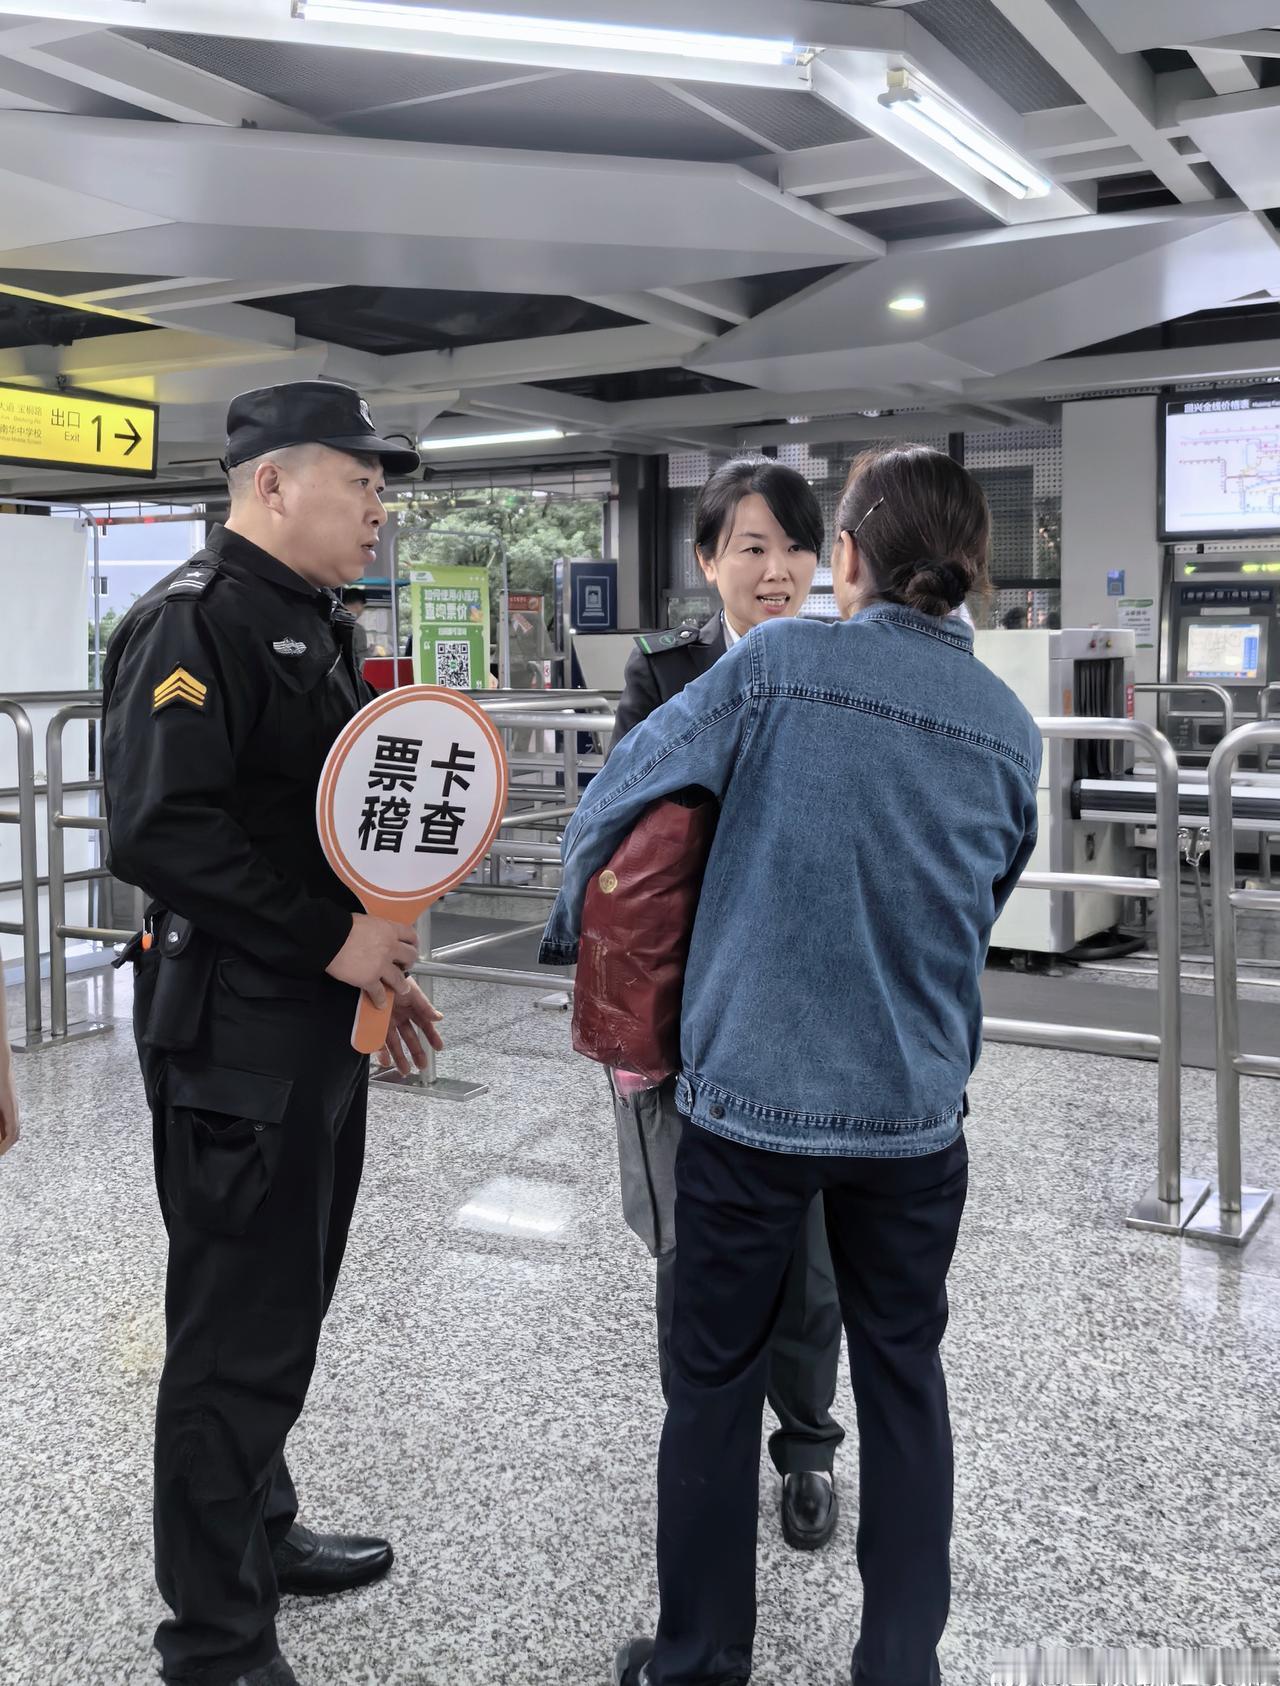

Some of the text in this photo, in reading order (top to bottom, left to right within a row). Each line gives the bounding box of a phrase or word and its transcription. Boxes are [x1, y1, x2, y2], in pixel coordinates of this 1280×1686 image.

[51, 408, 80, 428] 出口
[64, 431, 80, 443] Exit
[91, 415, 101, 452] 1
[425, 602, 467, 621] 查询票价
[368, 735, 475, 797] 票卡
[359, 795, 466, 855] 稽查
